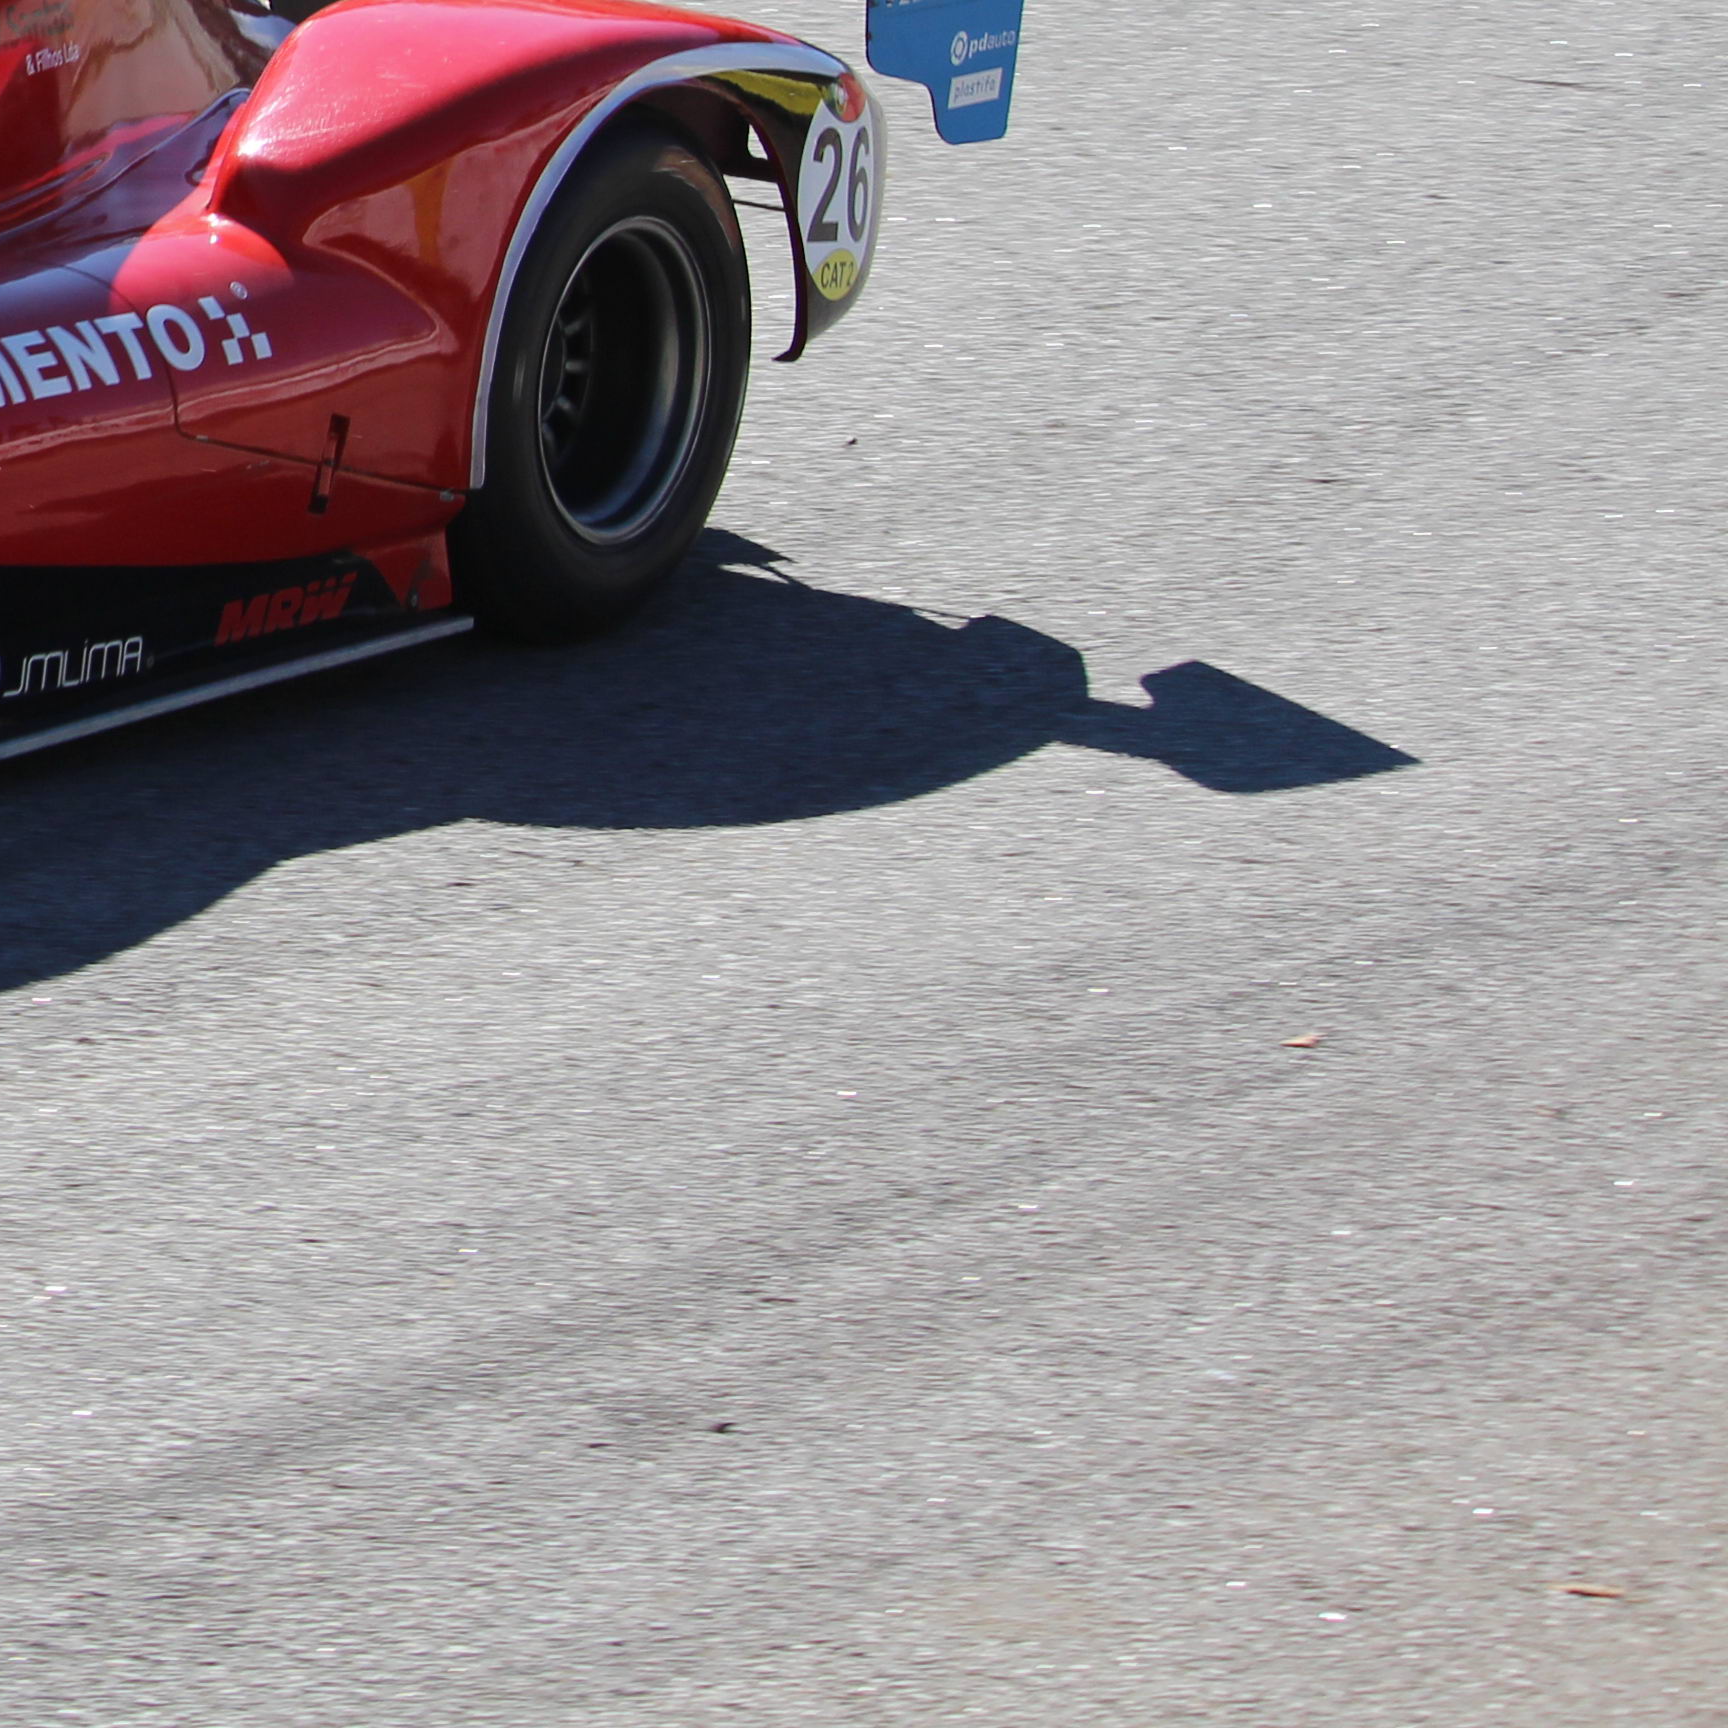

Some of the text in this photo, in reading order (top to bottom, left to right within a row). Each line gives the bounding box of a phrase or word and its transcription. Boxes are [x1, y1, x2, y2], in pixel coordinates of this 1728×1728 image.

[968, 27, 1017, 60] pdauto
[807, 126, 871, 244] 26
[820, 258, 856, 290] CAT 2
[213, 569, 359, 648] MRW
